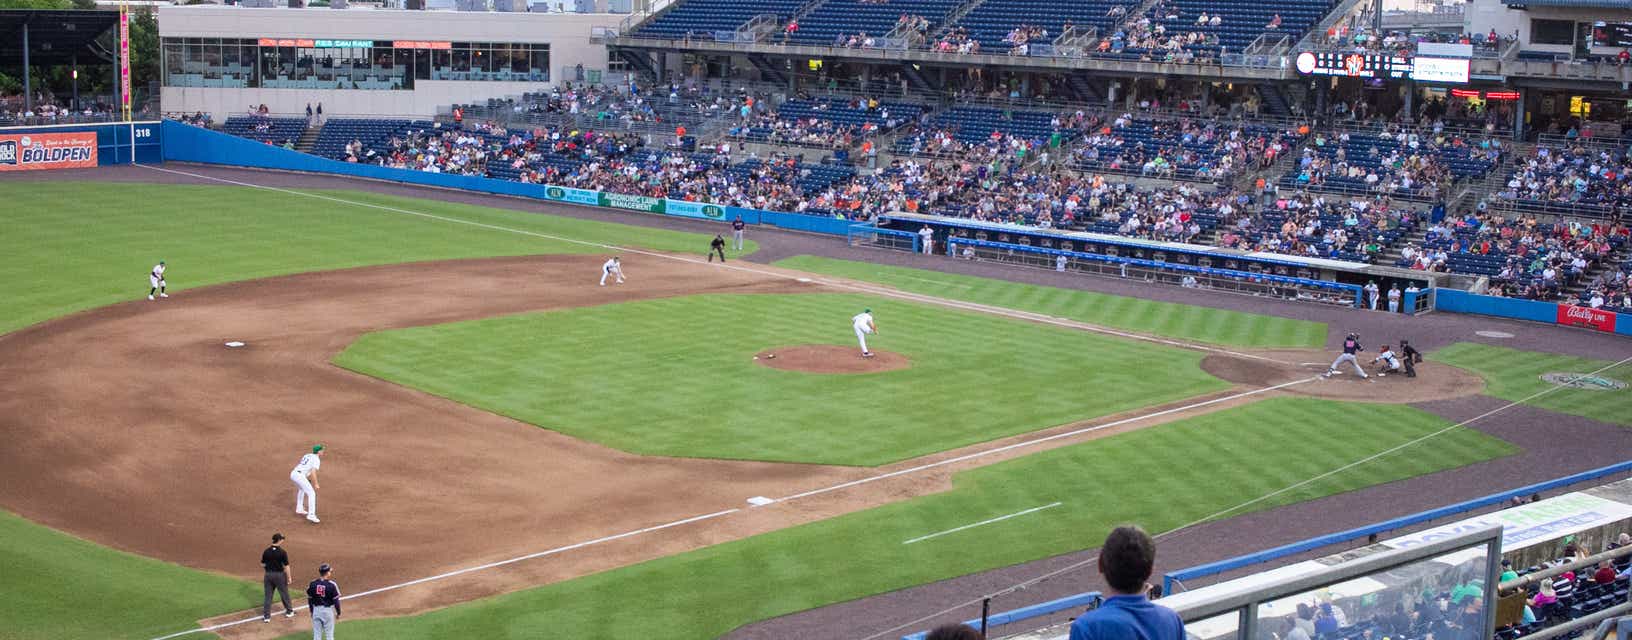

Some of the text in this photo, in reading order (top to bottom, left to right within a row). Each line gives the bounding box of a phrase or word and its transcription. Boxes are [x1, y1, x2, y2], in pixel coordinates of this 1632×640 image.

[136, 129, 150, 138] 318
[22, 147, 91, 163] BOLDPEN
[604, 192, 658, 206] AGRONOMIC LAWN
[610, 200, 652, 211] MANAGEMENT
